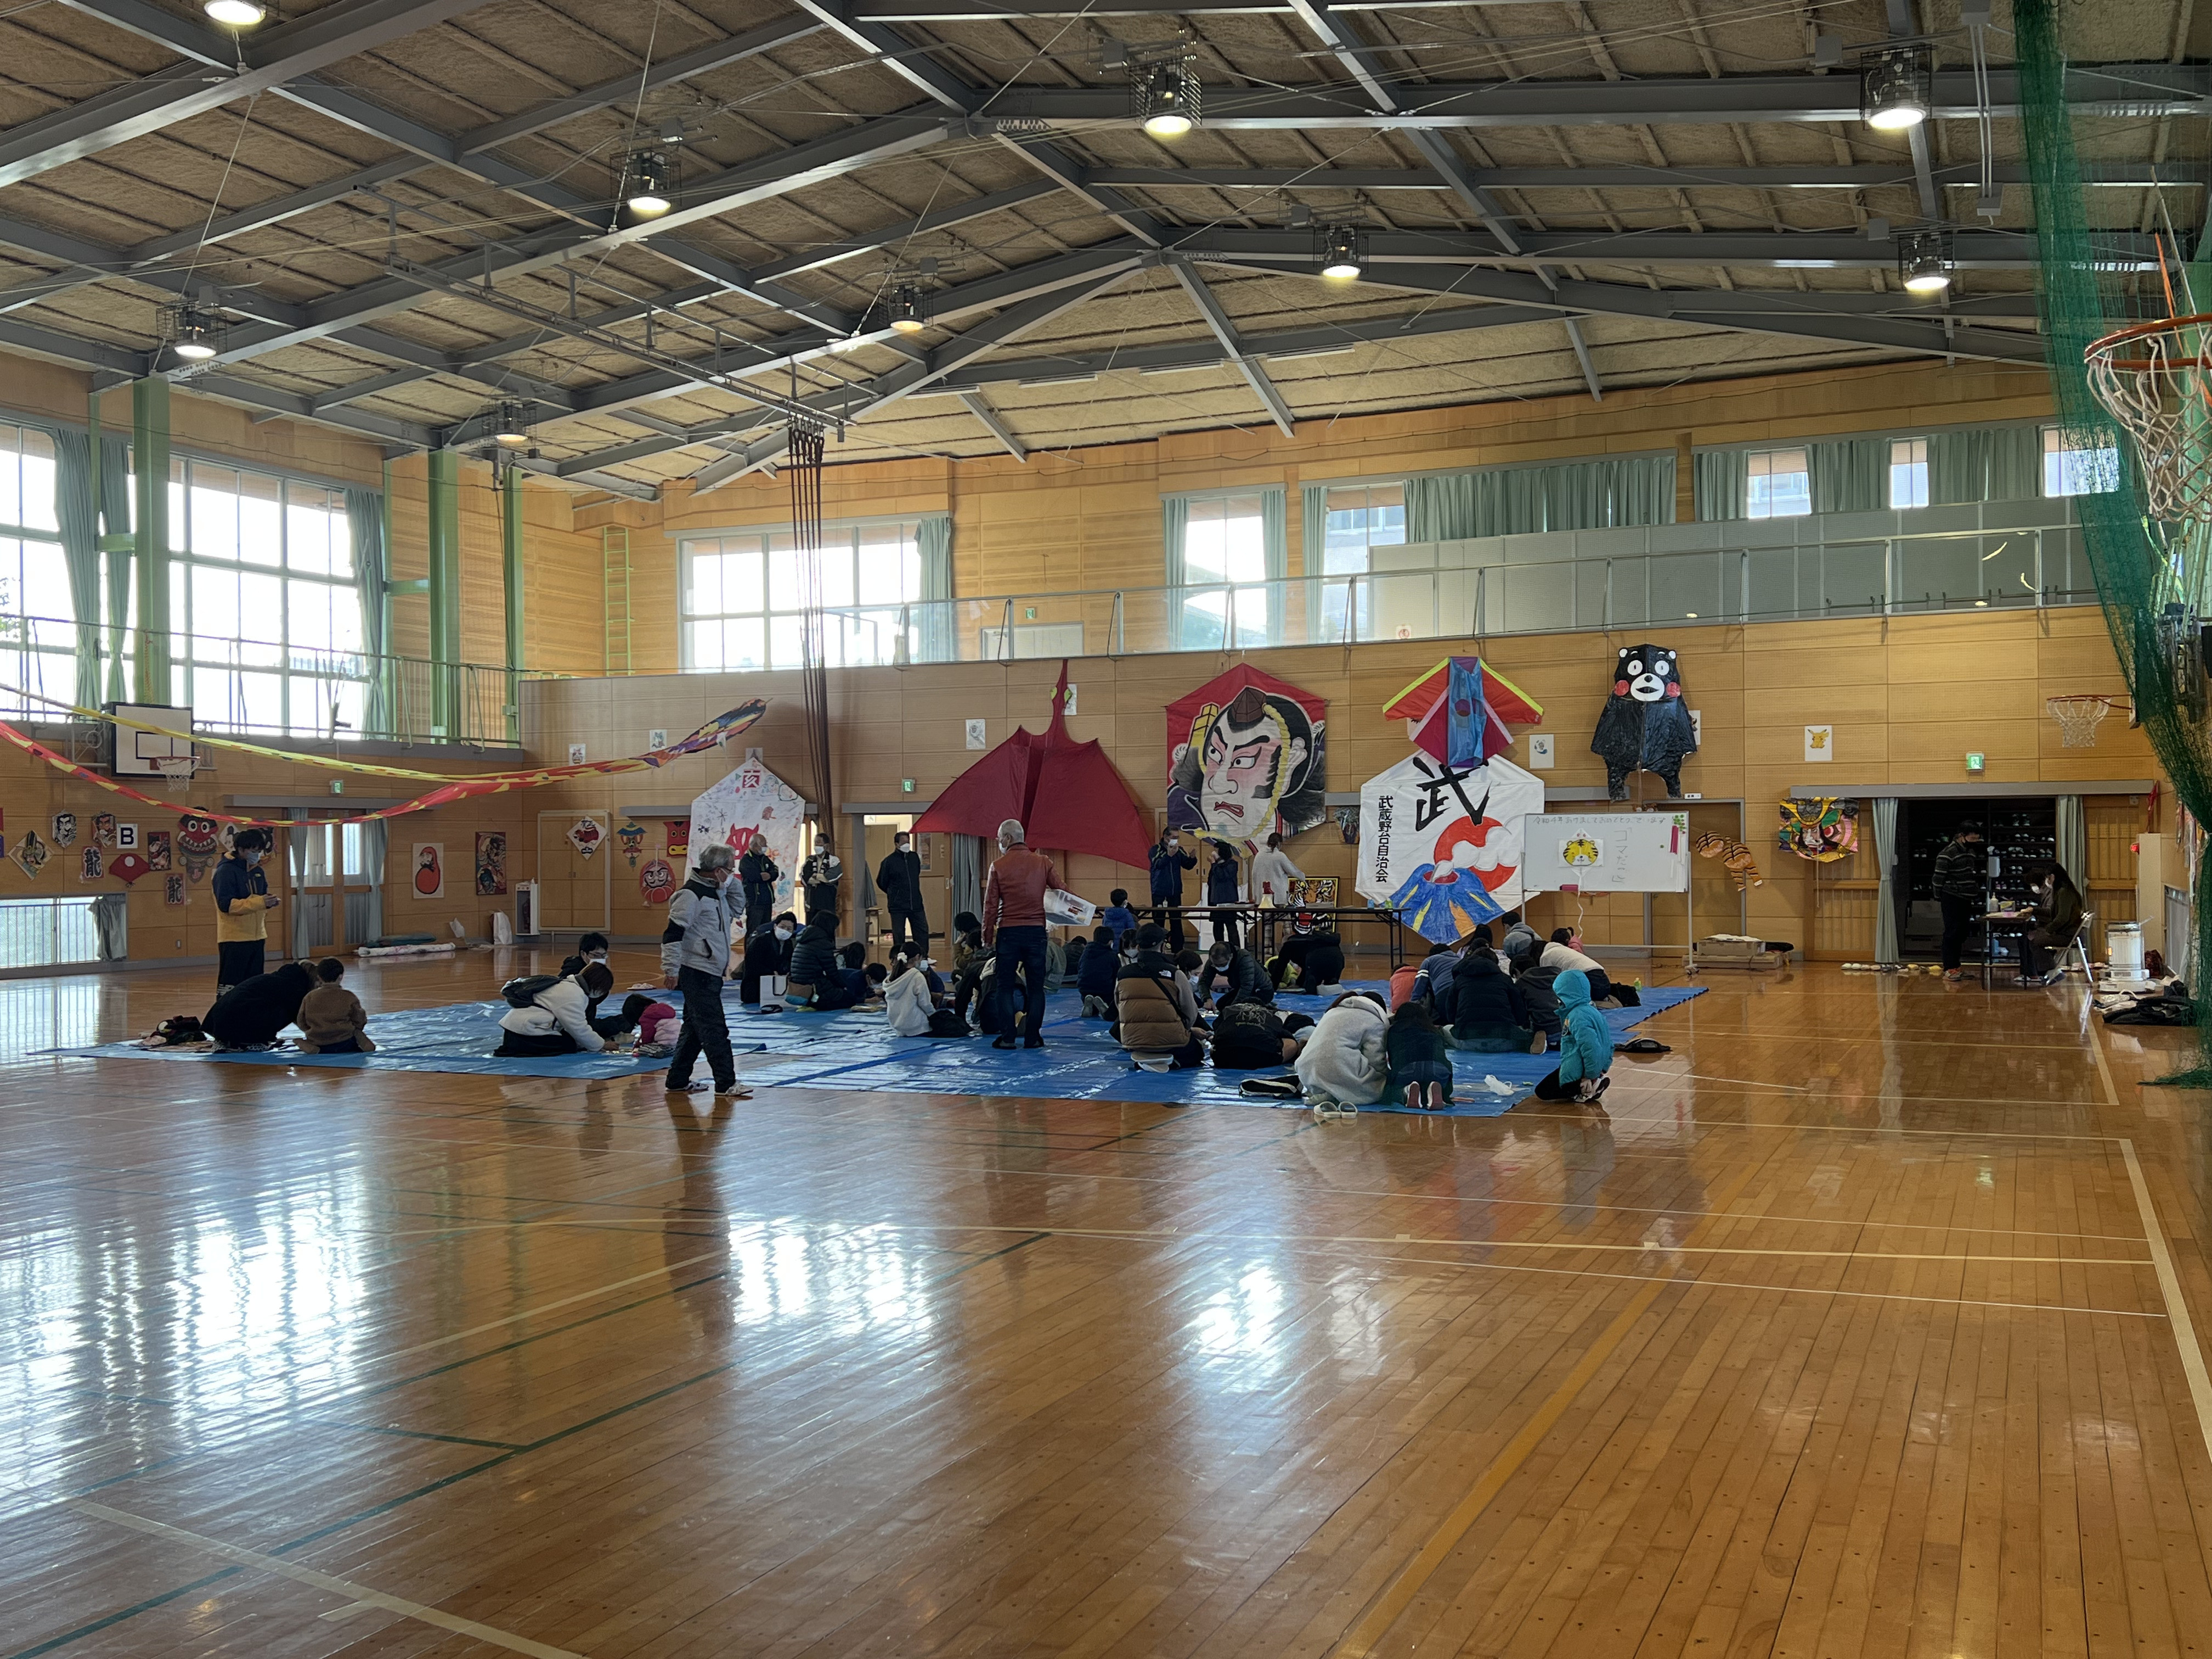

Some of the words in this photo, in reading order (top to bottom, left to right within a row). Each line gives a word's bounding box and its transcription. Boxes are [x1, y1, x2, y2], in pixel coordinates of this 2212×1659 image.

[1413, 757, 1492, 832] 武
[120, 827, 134, 845] B
[1375, 795, 1393, 883] 武蔵野台自治会
[84, 848, 101, 877] 龍
